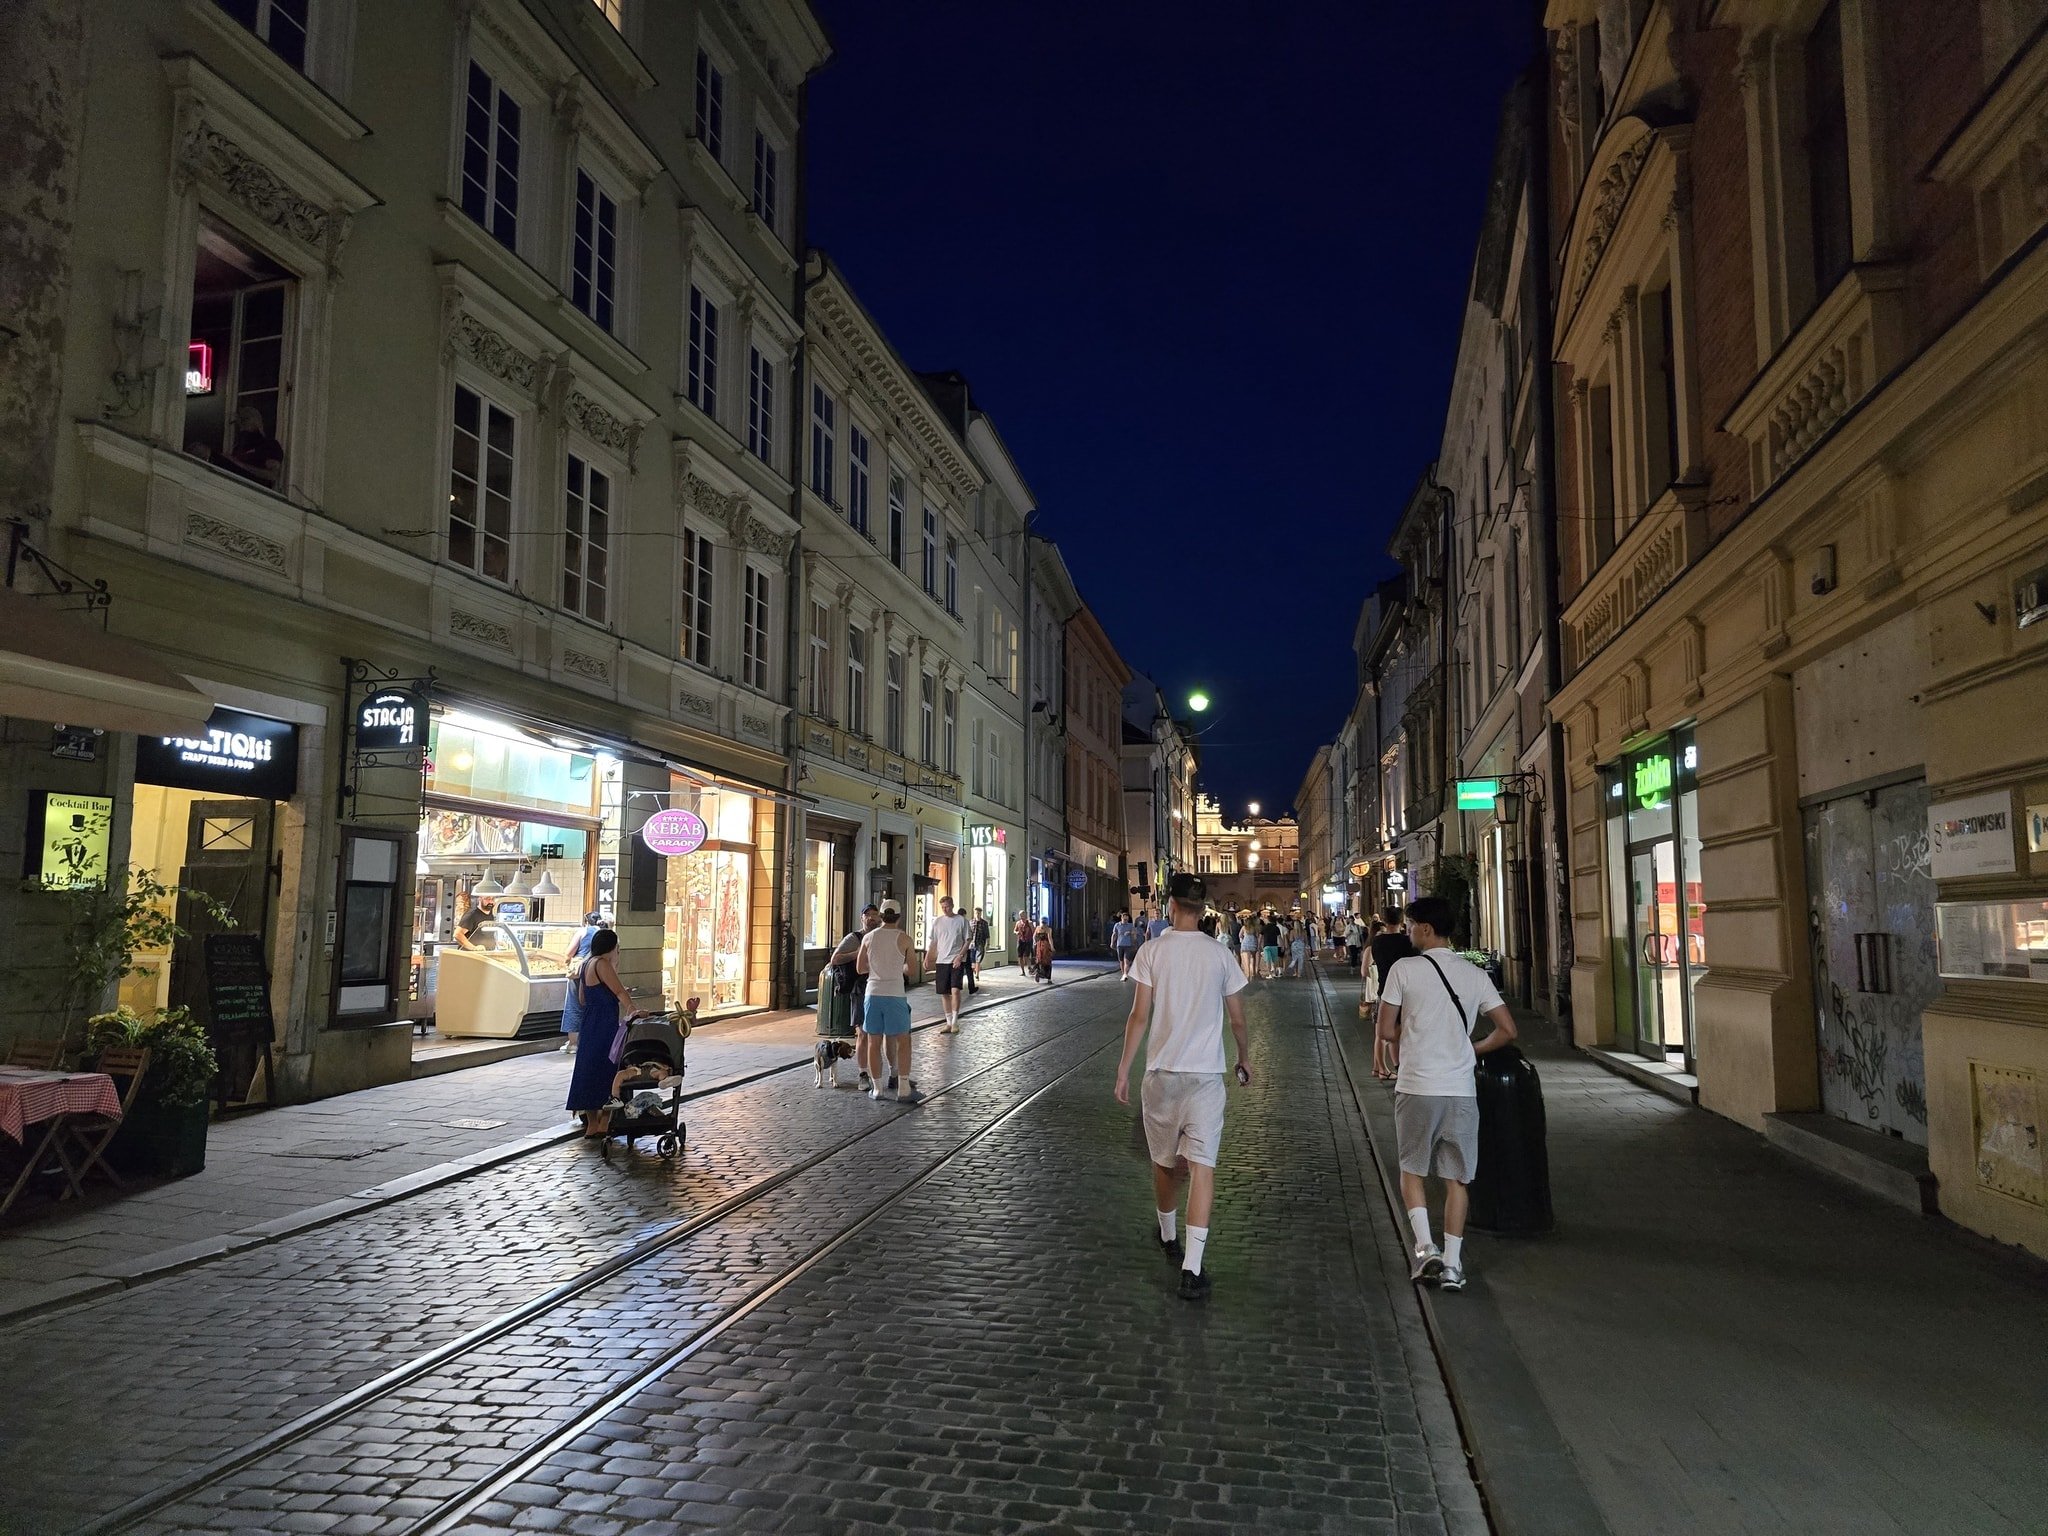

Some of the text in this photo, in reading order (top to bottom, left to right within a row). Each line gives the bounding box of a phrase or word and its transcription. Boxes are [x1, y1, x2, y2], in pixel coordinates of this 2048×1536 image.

[363, 706, 415, 727] STACJA
[400, 724, 414, 744] 21
[49, 797, 110, 811] Cocktail Bar
[648, 822, 702, 836] KEBAB
[971, 826, 992, 846] YES
[651, 839, 696, 847] FARAON
[916, 897, 924, 947] KANTOR
